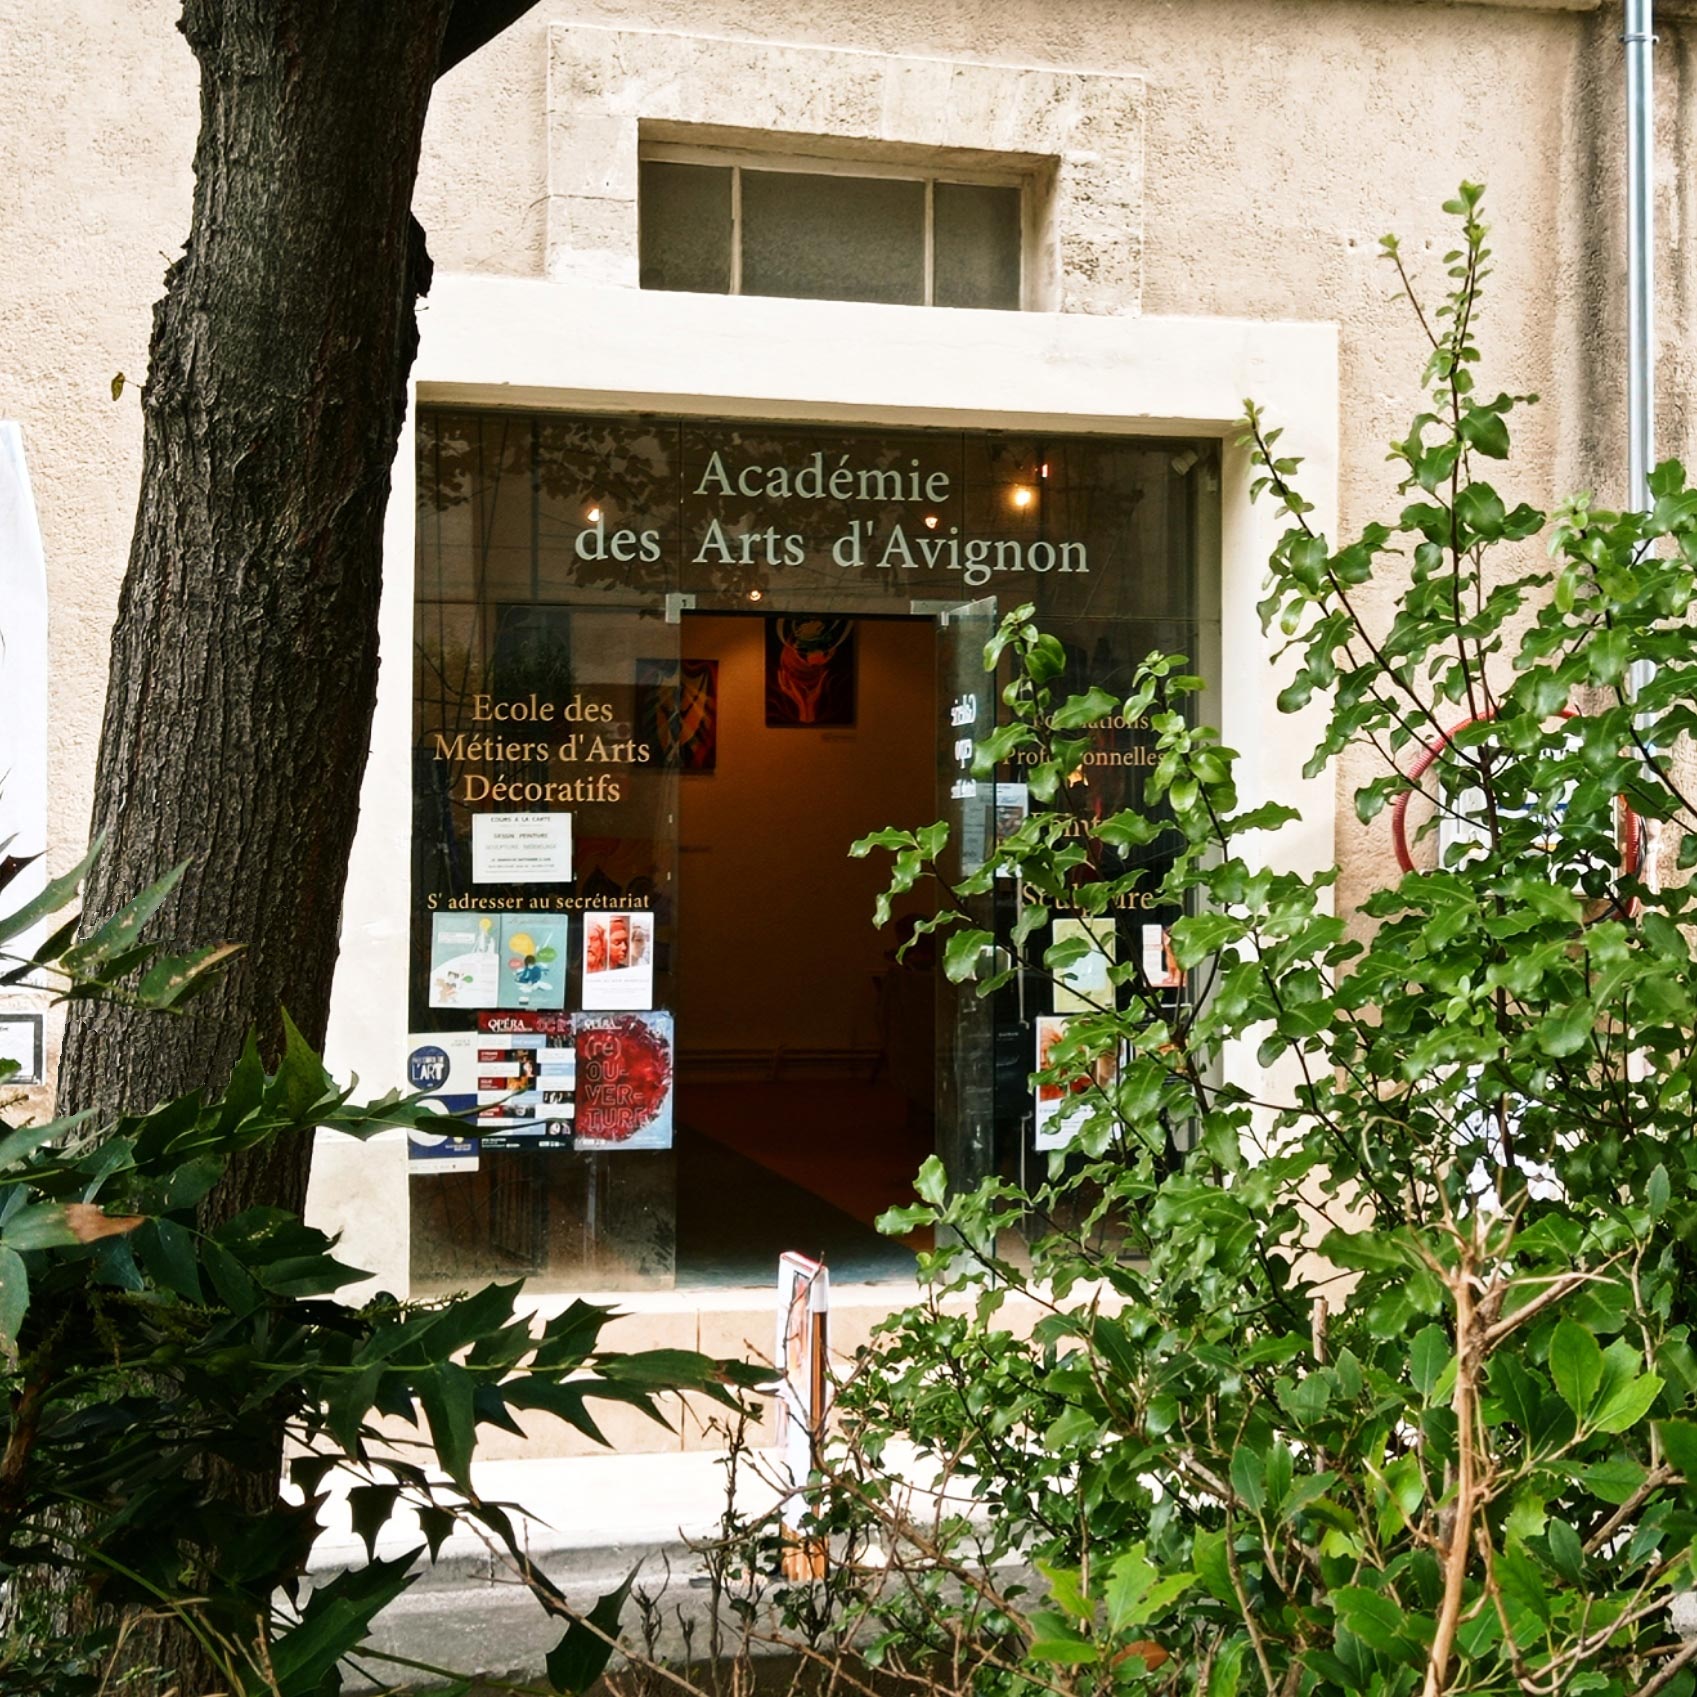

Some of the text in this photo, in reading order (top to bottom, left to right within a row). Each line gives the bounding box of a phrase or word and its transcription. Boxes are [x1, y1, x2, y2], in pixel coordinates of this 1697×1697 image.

[693, 451, 950, 503] Académie
[575, 511, 1090, 586] des Arts d'Avignon
[472, 694, 613, 722] Ecole des
[433, 733, 650, 763] Métiers d'Arts
[463, 773, 621, 802] Décoratifs
[427, 892, 650, 909] S' adresser au secrétariat
